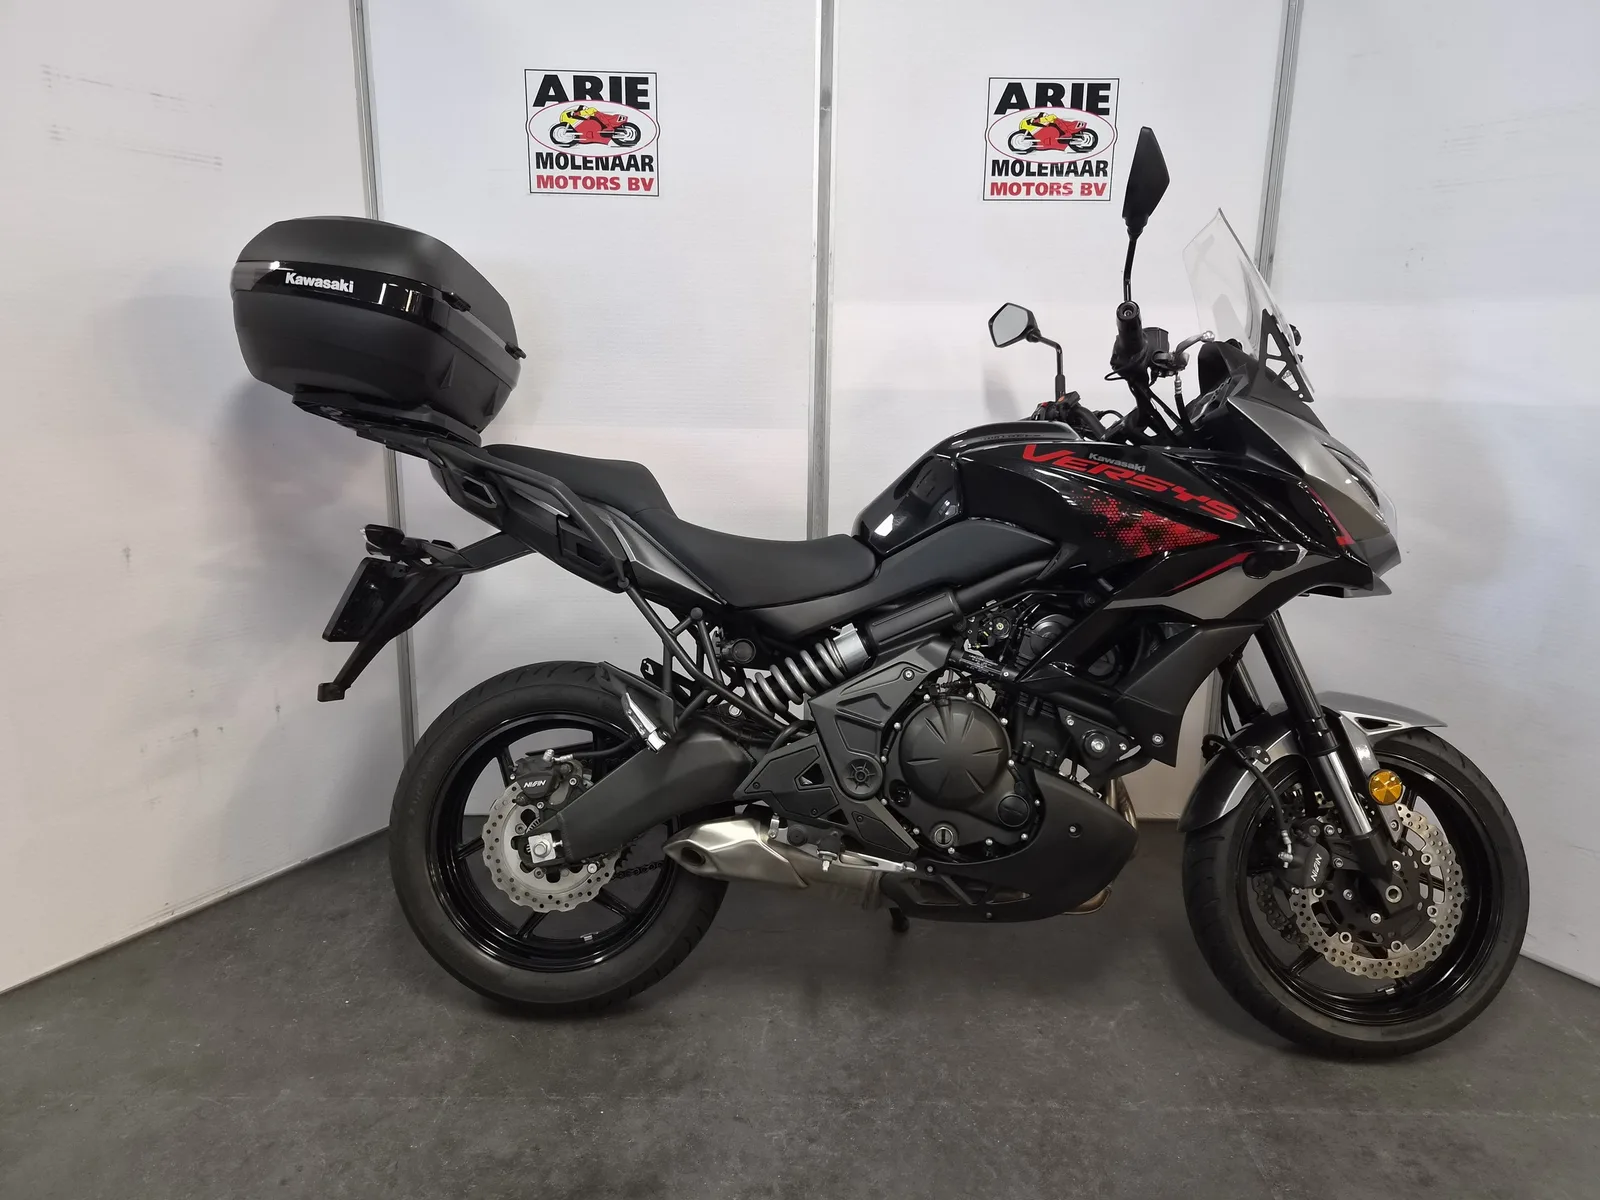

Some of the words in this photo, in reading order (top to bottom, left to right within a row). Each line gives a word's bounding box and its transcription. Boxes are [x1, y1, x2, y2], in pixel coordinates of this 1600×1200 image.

[532, 74, 651, 110] ARIE
[993, 82, 1112, 116] ARIE
[535, 152, 655, 172] MOLENAAR
[991, 159, 1109, 177] MOLENAAR
[536, 174, 621, 191] MOTORS
[627, 176, 655, 192] BV
[990, 182, 1074, 196] MOTORS
[1080, 182, 1107, 196] BV
[285, 271, 354, 293] Kawasaki
[1088, 452, 1147, 473] Kawasaki
[1022, 444, 1242, 521] VERSYS
